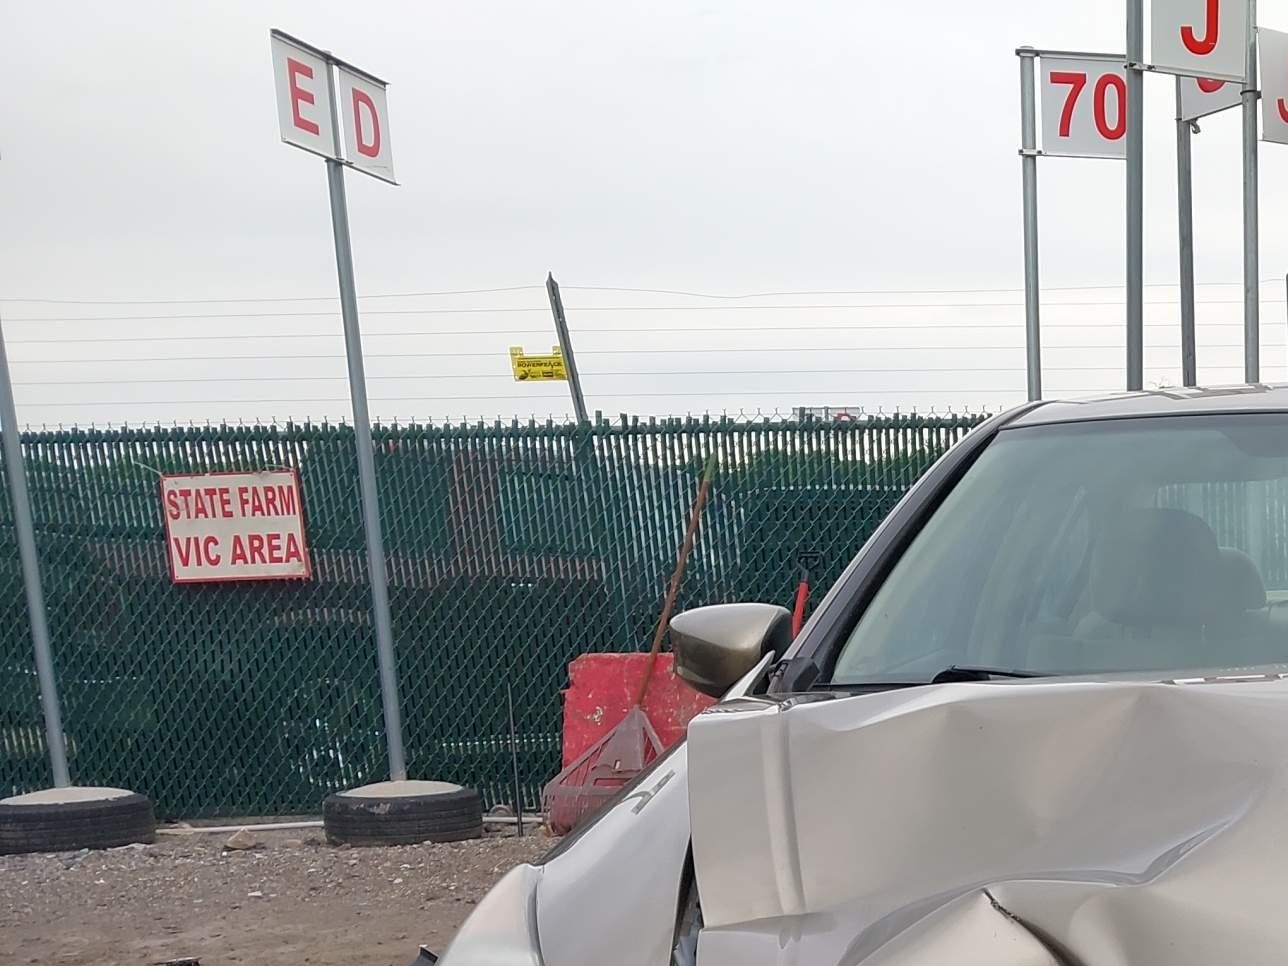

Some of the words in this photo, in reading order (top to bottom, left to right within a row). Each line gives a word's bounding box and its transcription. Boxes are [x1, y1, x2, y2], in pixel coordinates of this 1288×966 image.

[286, 56, 320, 137] E
[351, 86, 381, 159] D
[1049, 71, 1127, 141] 70
[166, 487, 234, 520] STATE
[238, 485, 297, 518] FARM
[172, 535, 222, 568] VIC
[230, 532, 303, 566] AREA
